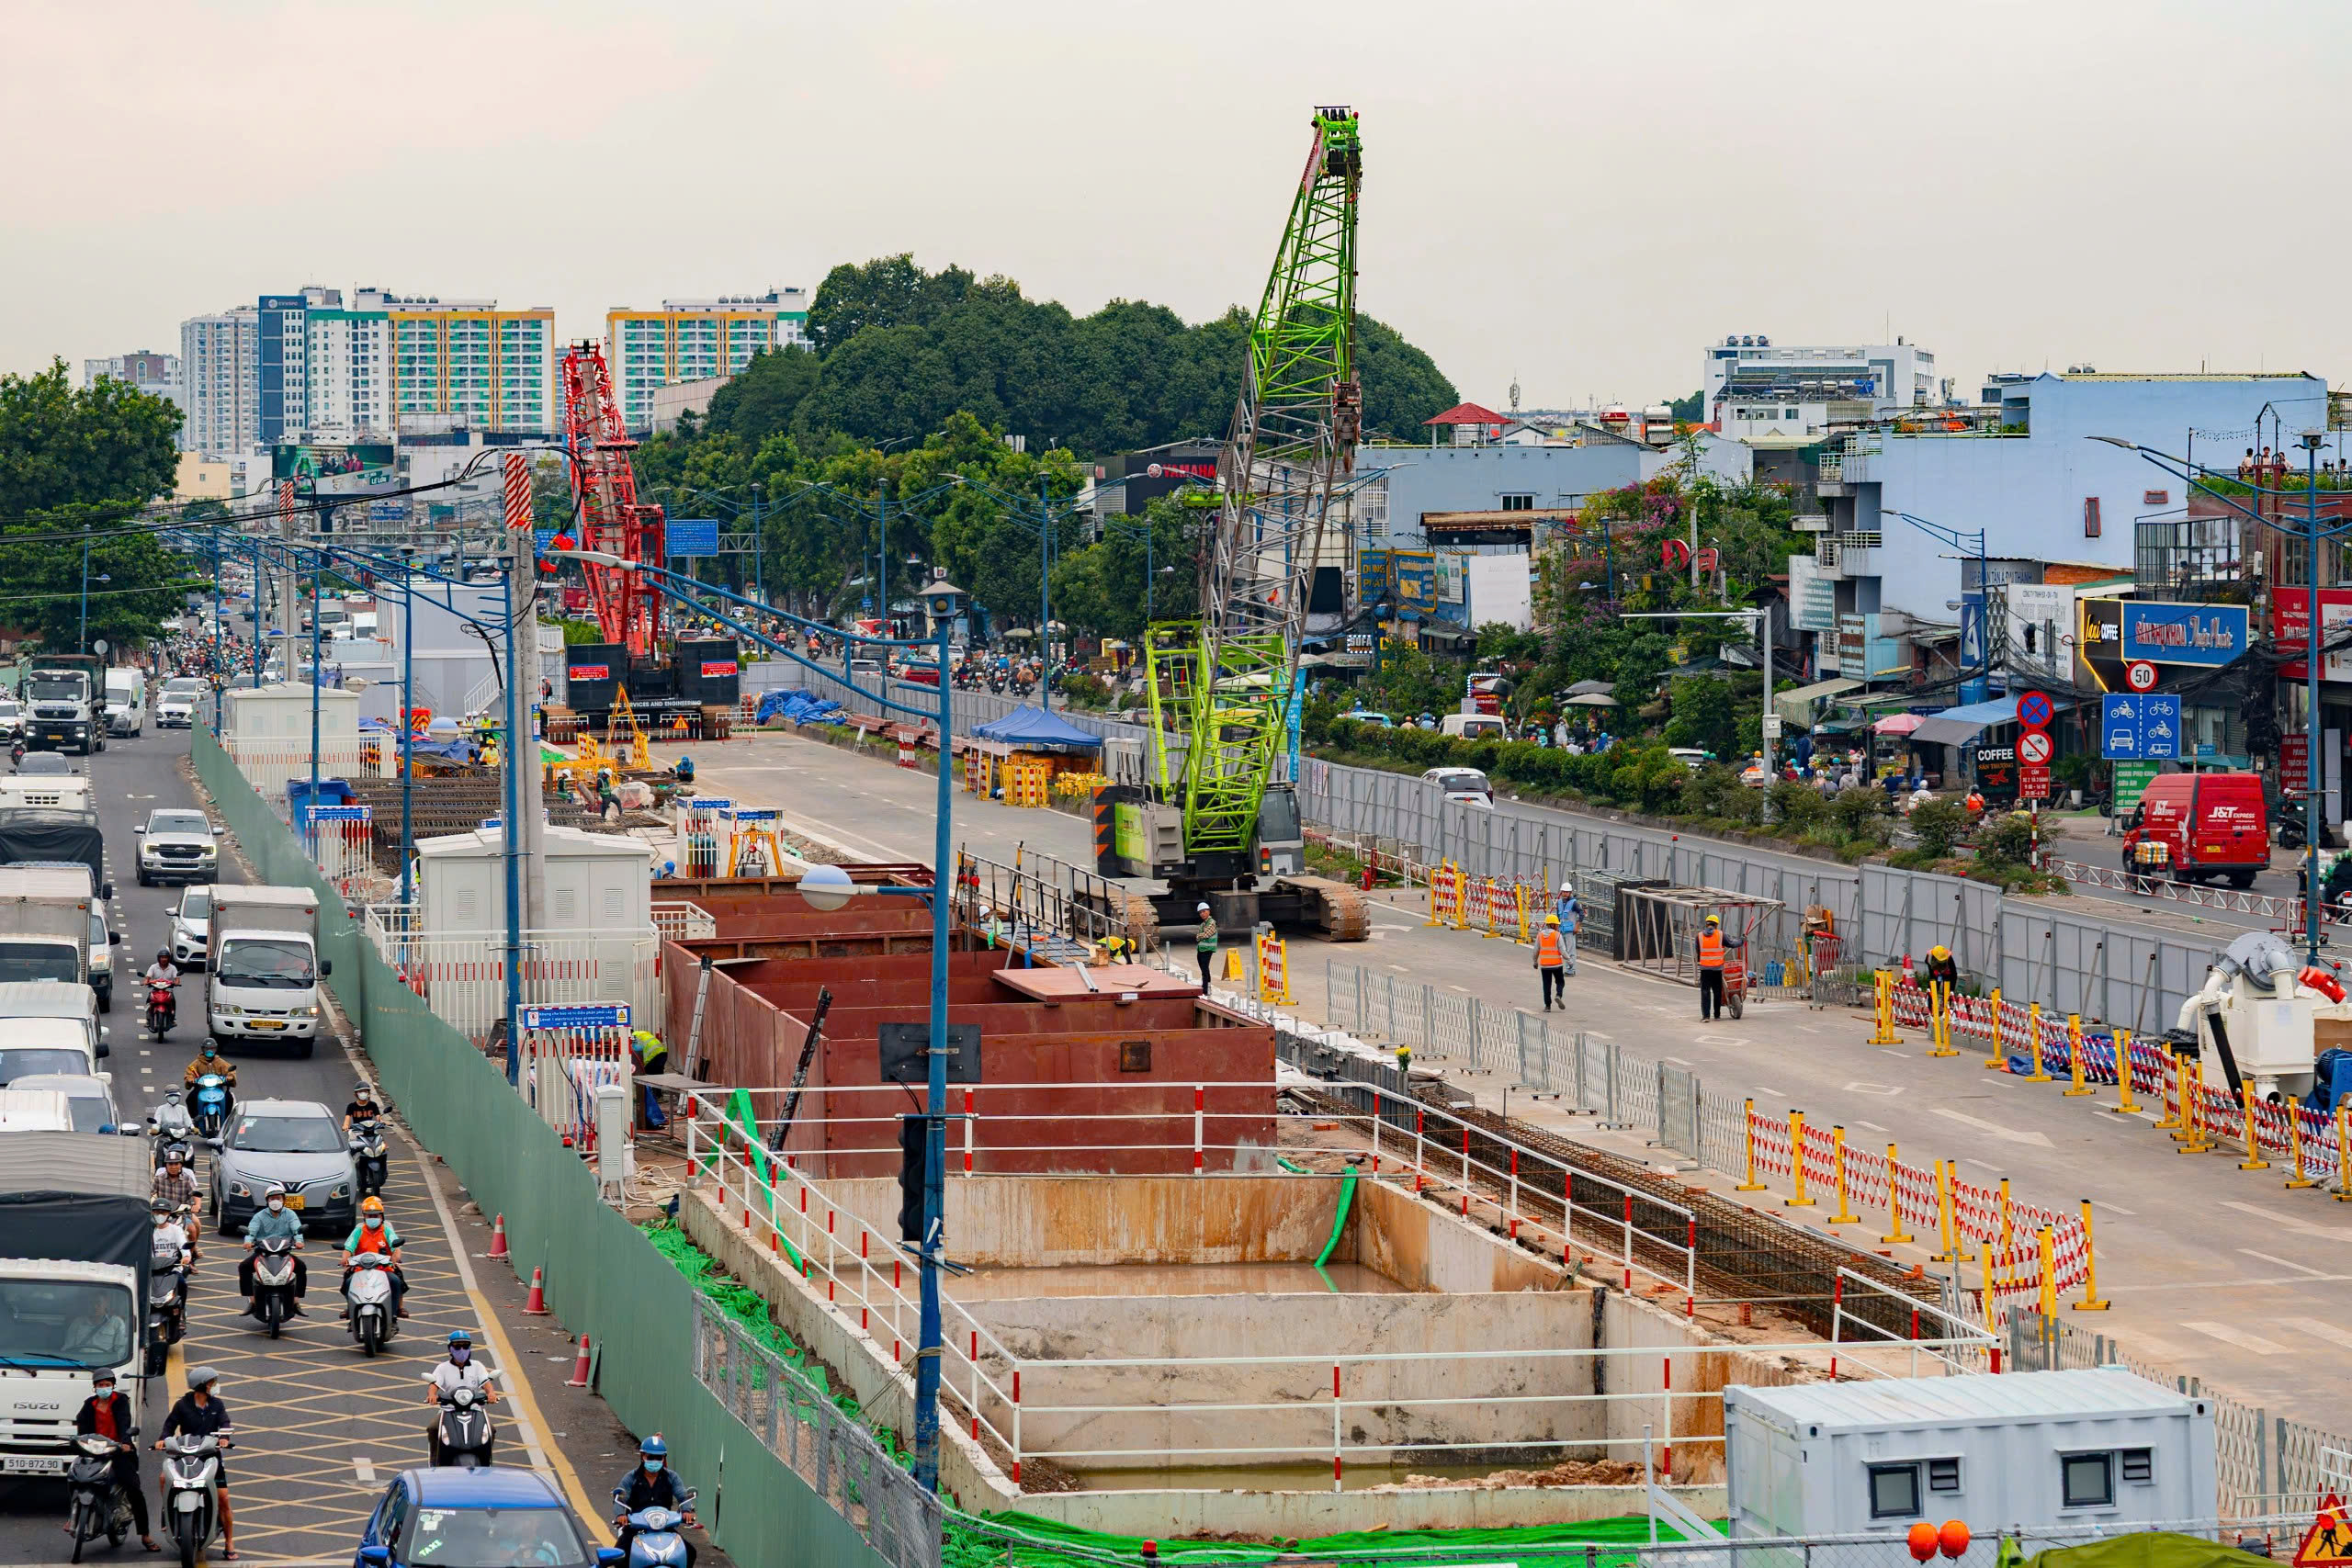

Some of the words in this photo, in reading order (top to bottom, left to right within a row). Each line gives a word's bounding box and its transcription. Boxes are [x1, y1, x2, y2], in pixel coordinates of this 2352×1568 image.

[1162, 463, 1216, 479] YAMAHA
[2101, 623, 2119, 641] COFFEE
[1350, 637, 1372, 647] SOFA
[2135, 670, 2150, 683] 50
[1977, 748, 2014, 761] COFFEE
[2208, 807, 2239, 818] J&T
[13, 1402, 60, 1410] ISUZU
[418, 1538, 443, 1558] TAXI
